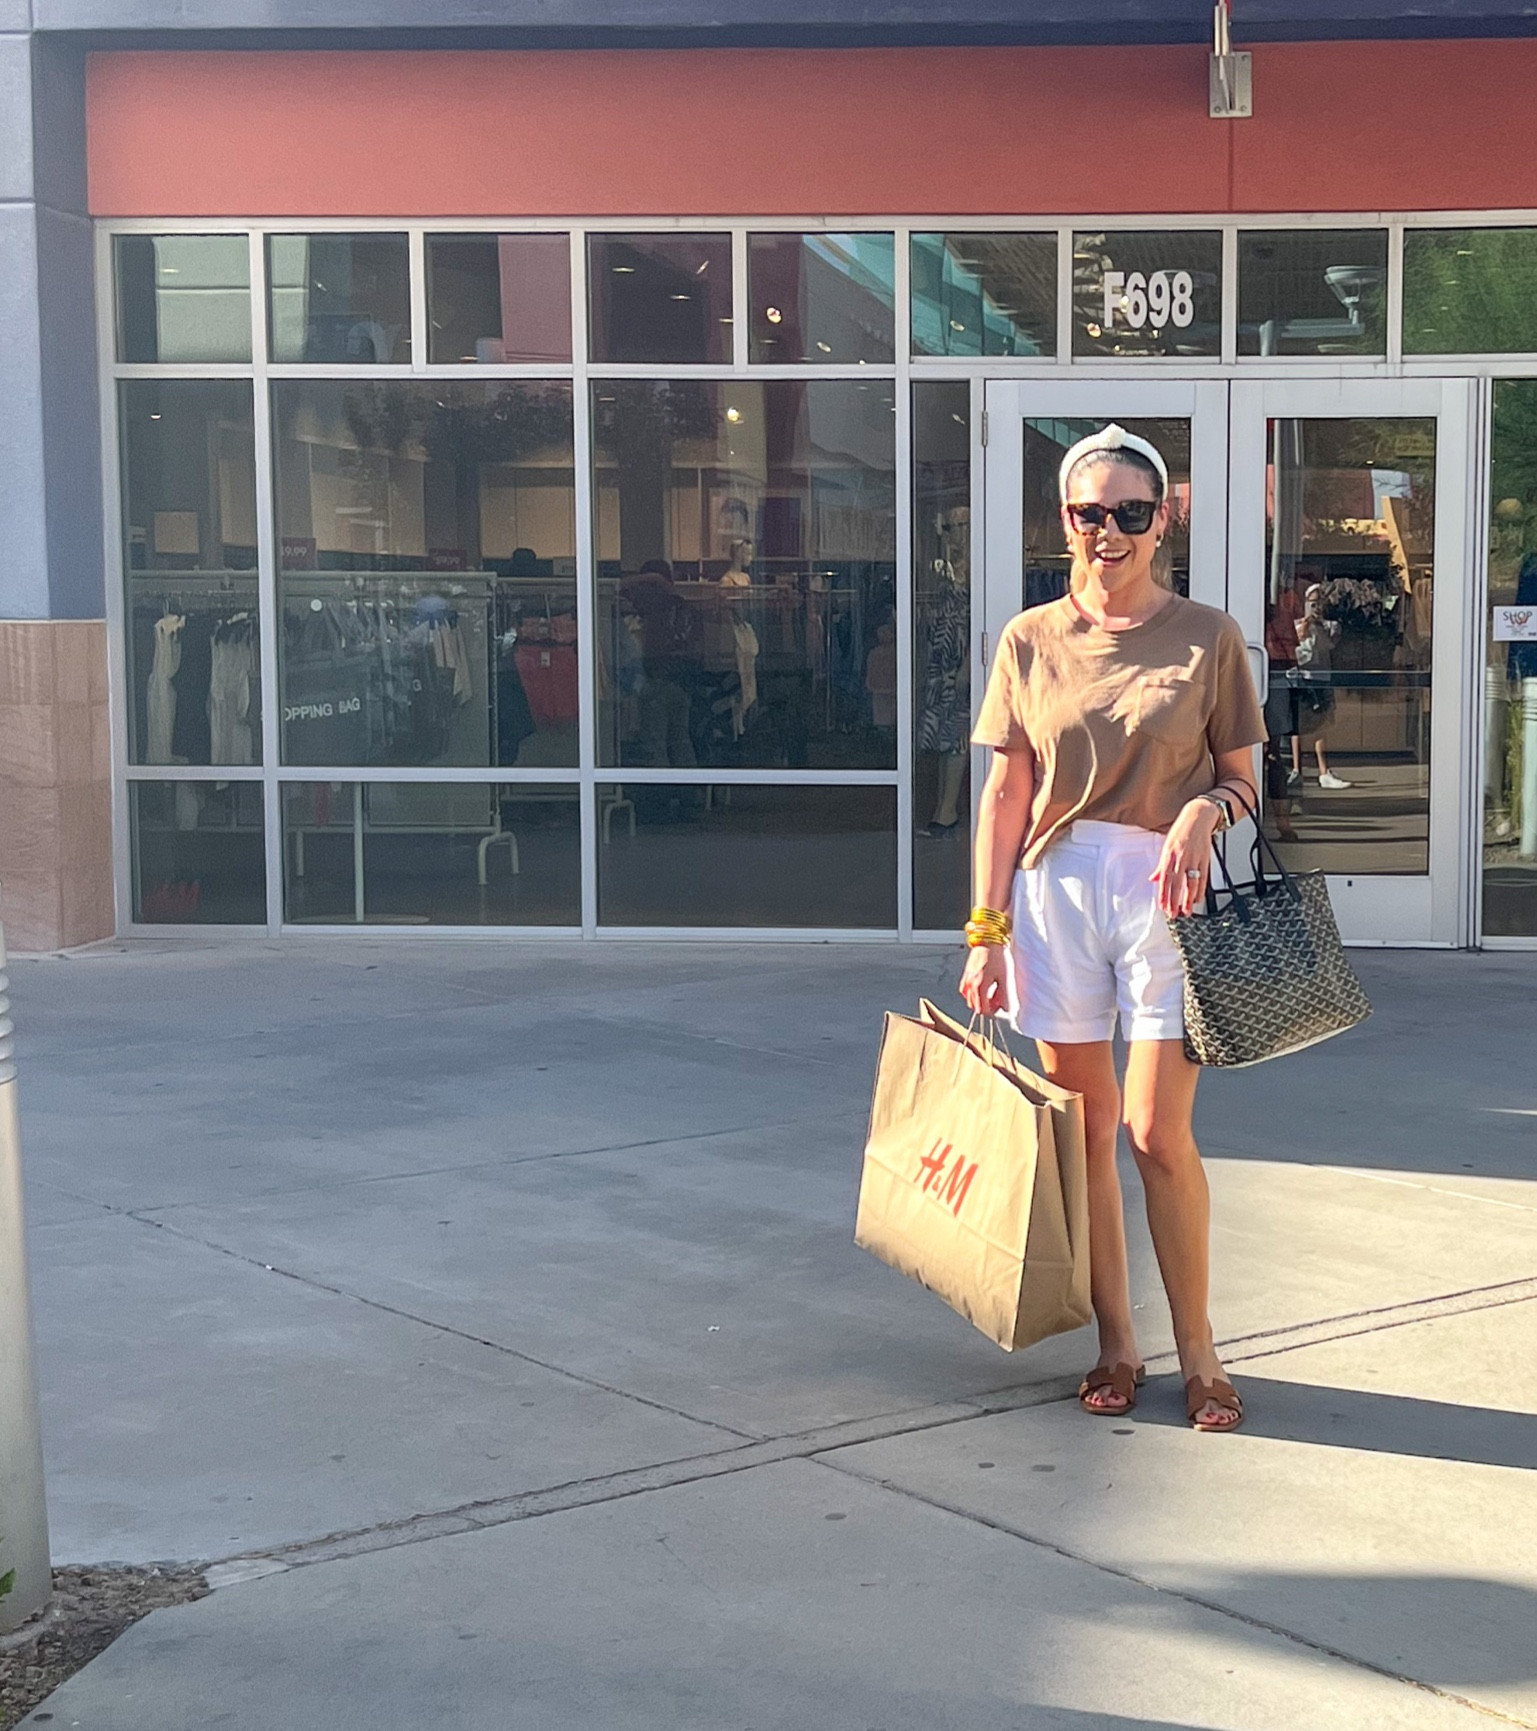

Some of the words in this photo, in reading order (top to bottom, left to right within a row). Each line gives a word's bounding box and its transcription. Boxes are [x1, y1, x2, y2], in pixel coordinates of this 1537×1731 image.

[1103, 270, 1194, 328] F698
[284, 703, 333, 721] OPPING
[338, 697, 361, 714] BAG
[913, 1136, 979, 1218] H&M
